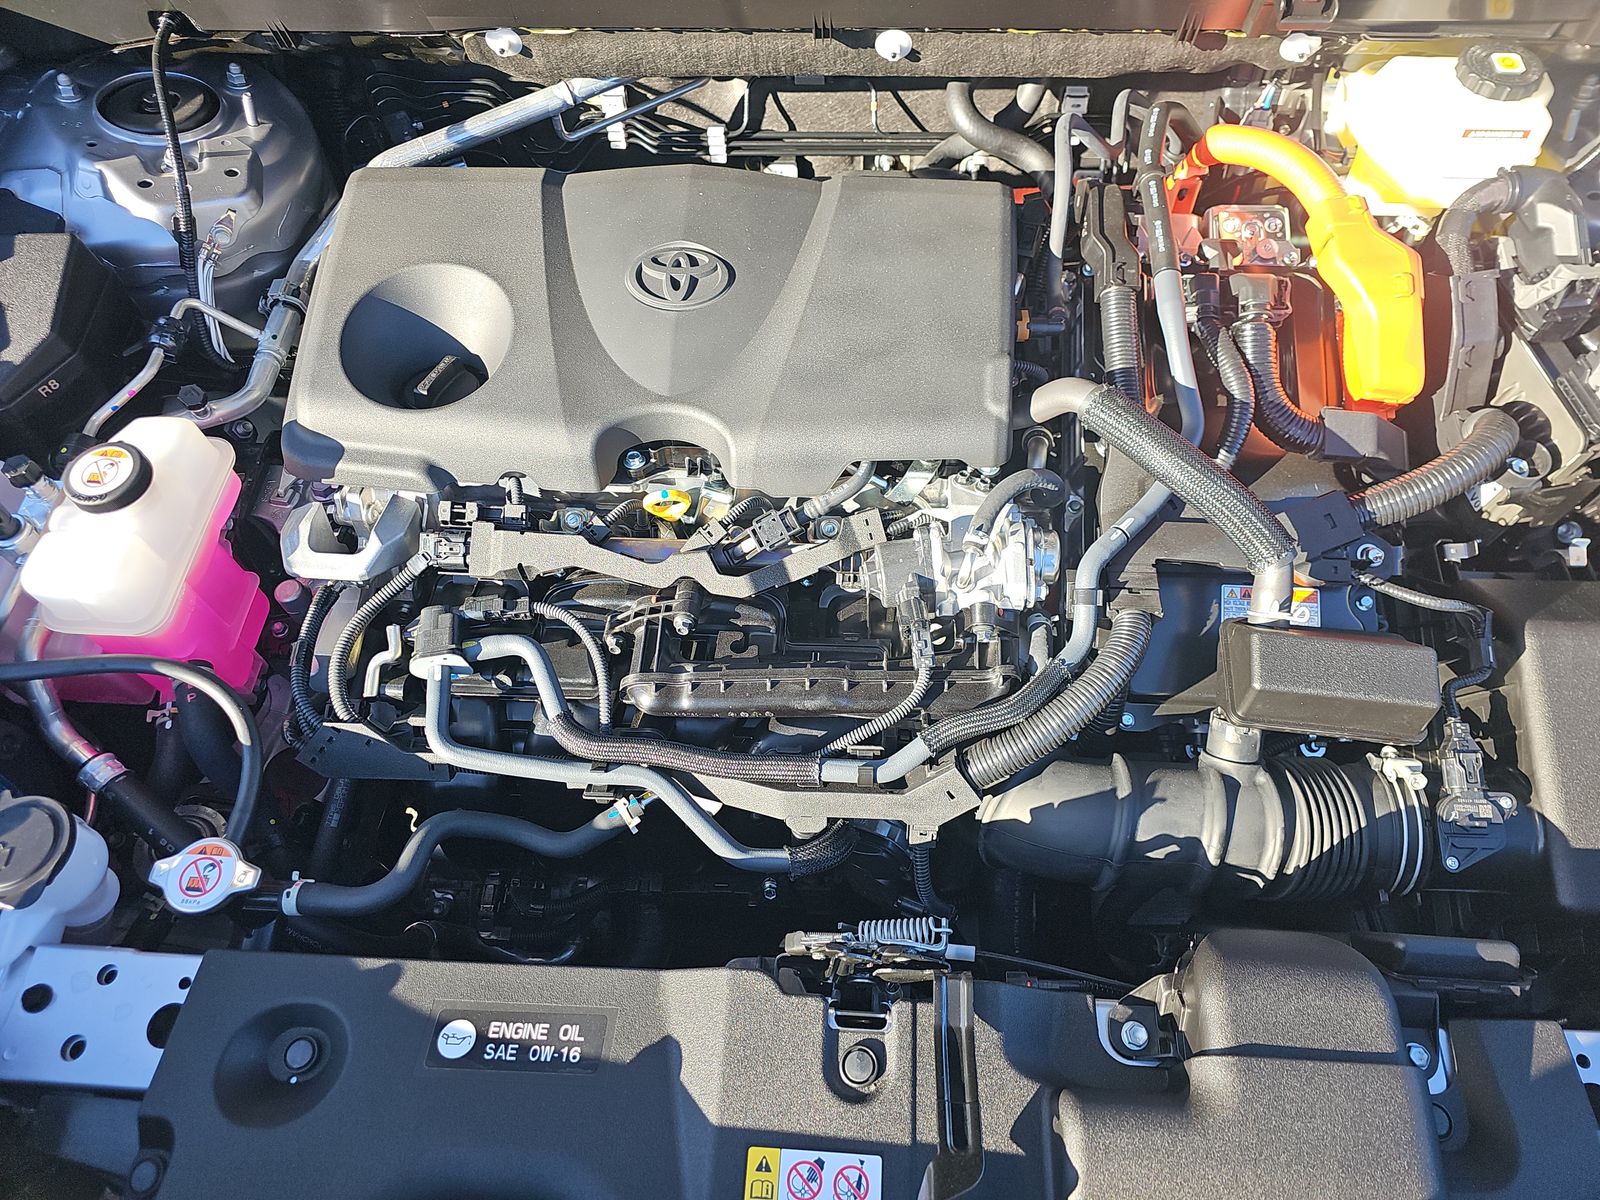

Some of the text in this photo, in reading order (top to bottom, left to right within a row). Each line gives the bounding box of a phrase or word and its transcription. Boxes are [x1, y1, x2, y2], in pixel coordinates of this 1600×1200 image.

[38, 379, 60, 397] R8
[488, 1021, 585, 1042] ENGINE OIL
[483, 1043, 582, 1063] SAE 0W-16
